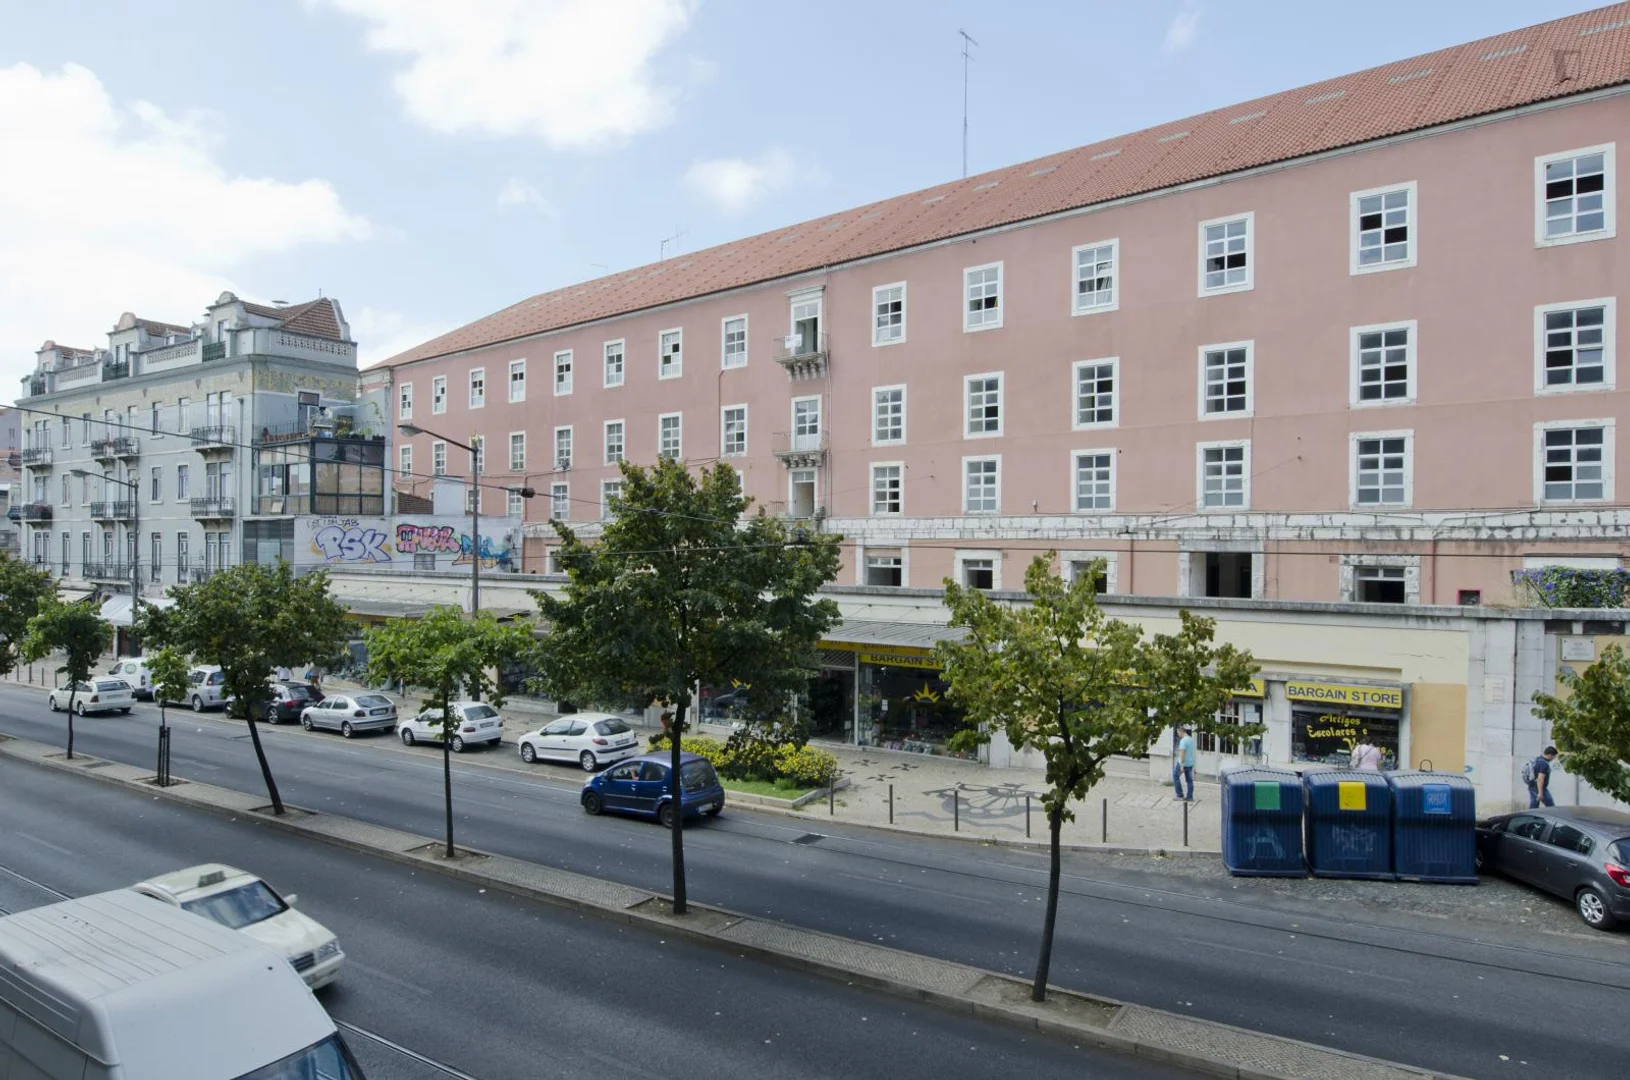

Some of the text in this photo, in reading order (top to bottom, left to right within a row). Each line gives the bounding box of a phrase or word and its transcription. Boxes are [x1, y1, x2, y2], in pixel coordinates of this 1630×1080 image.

[871, 654, 922, 666] BARGAIN
[1288, 686, 1400, 705] BARGAIN STORE
[1319, 714, 1361, 727] Artigos
[1306, 724, 1357, 738] Escolares
